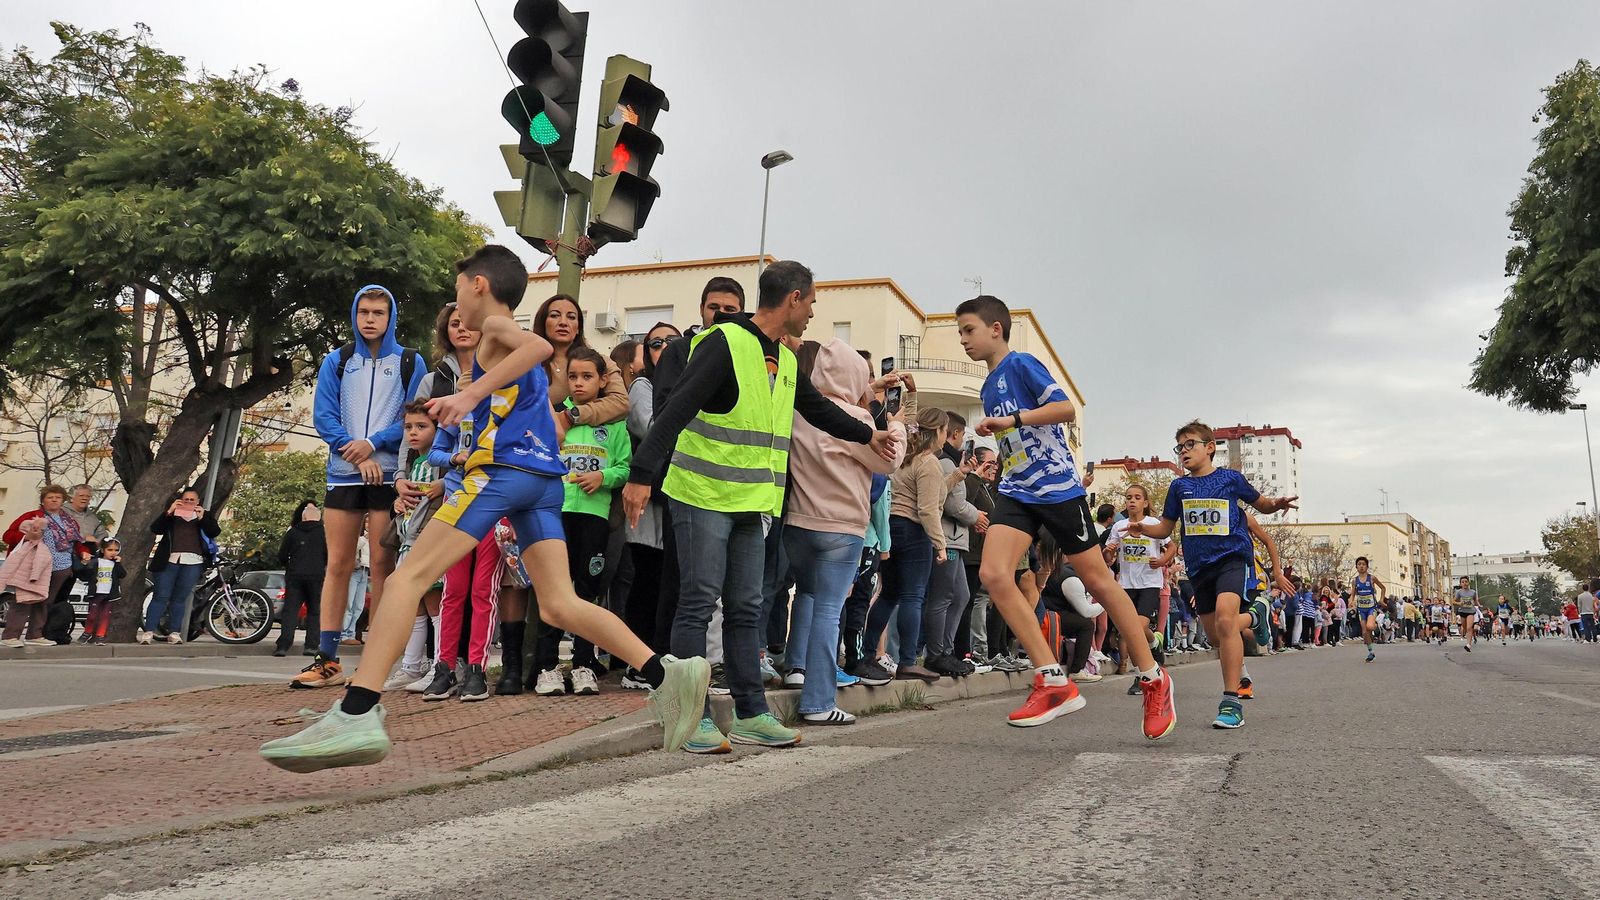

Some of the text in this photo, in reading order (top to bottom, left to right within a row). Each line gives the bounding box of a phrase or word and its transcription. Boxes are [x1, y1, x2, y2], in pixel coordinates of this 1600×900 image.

[563, 456, 600, 472] 138
[1189, 510, 1221, 524] 610
[1125, 546, 1147, 555] 672
[1041, 668, 1064, 677] FILA
